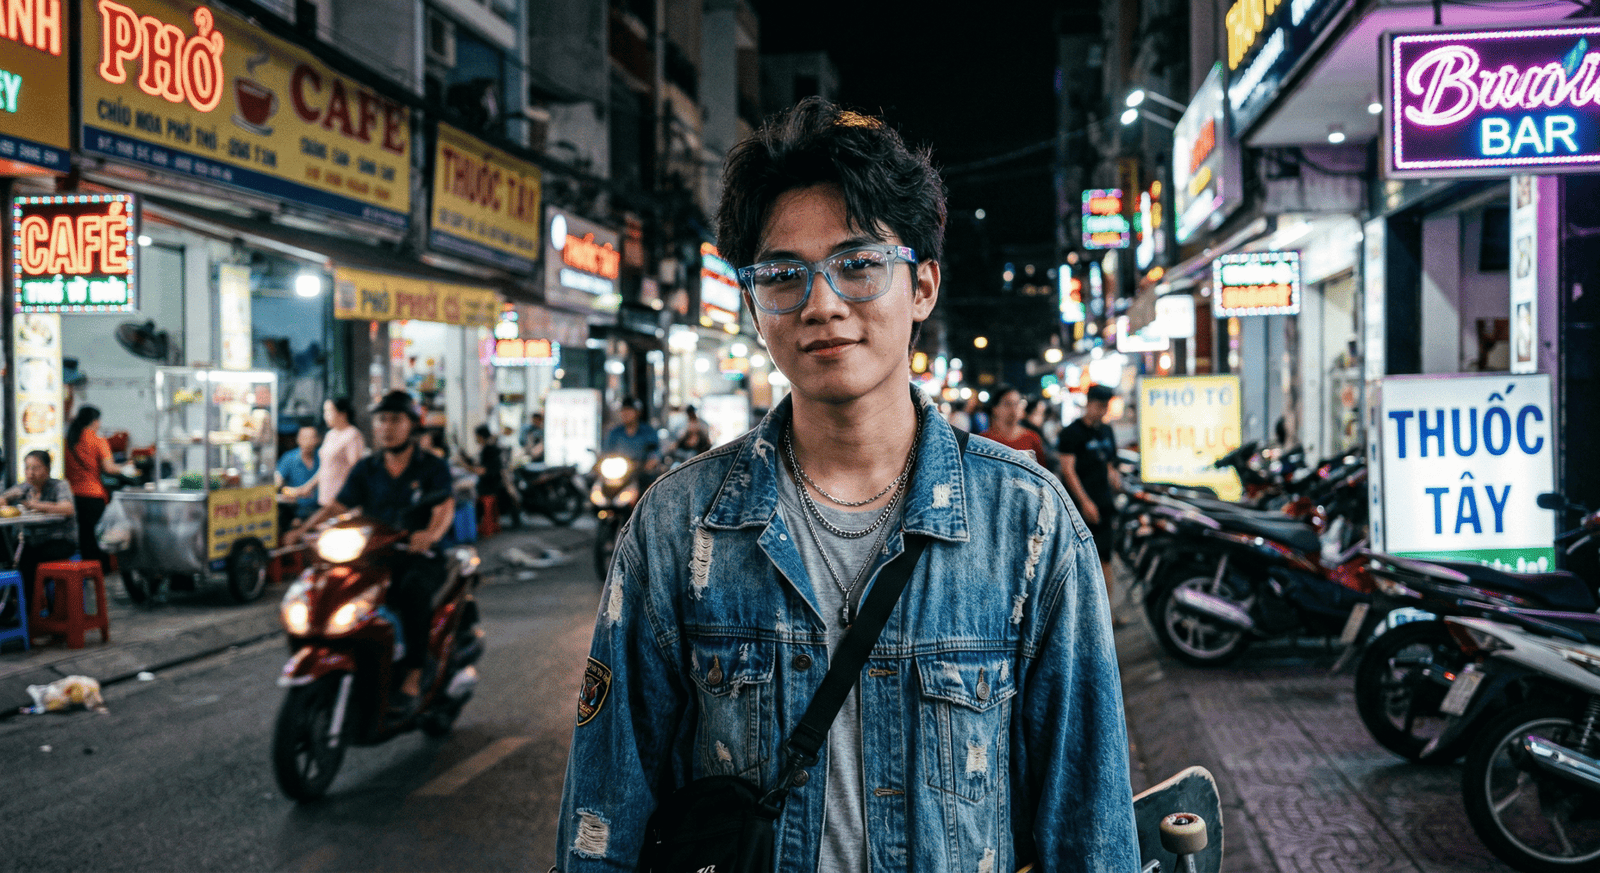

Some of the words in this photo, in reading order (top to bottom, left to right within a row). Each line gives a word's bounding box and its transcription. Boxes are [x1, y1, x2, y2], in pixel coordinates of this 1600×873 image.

[100, 1, 224, 112] PHỞ
[1481, 115, 1578, 155] BAR
[20, 201, 128, 275] CAFÉ
[1389, 384, 1544, 458] THUỐC
[1425, 471, 1511, 534] TÂY
